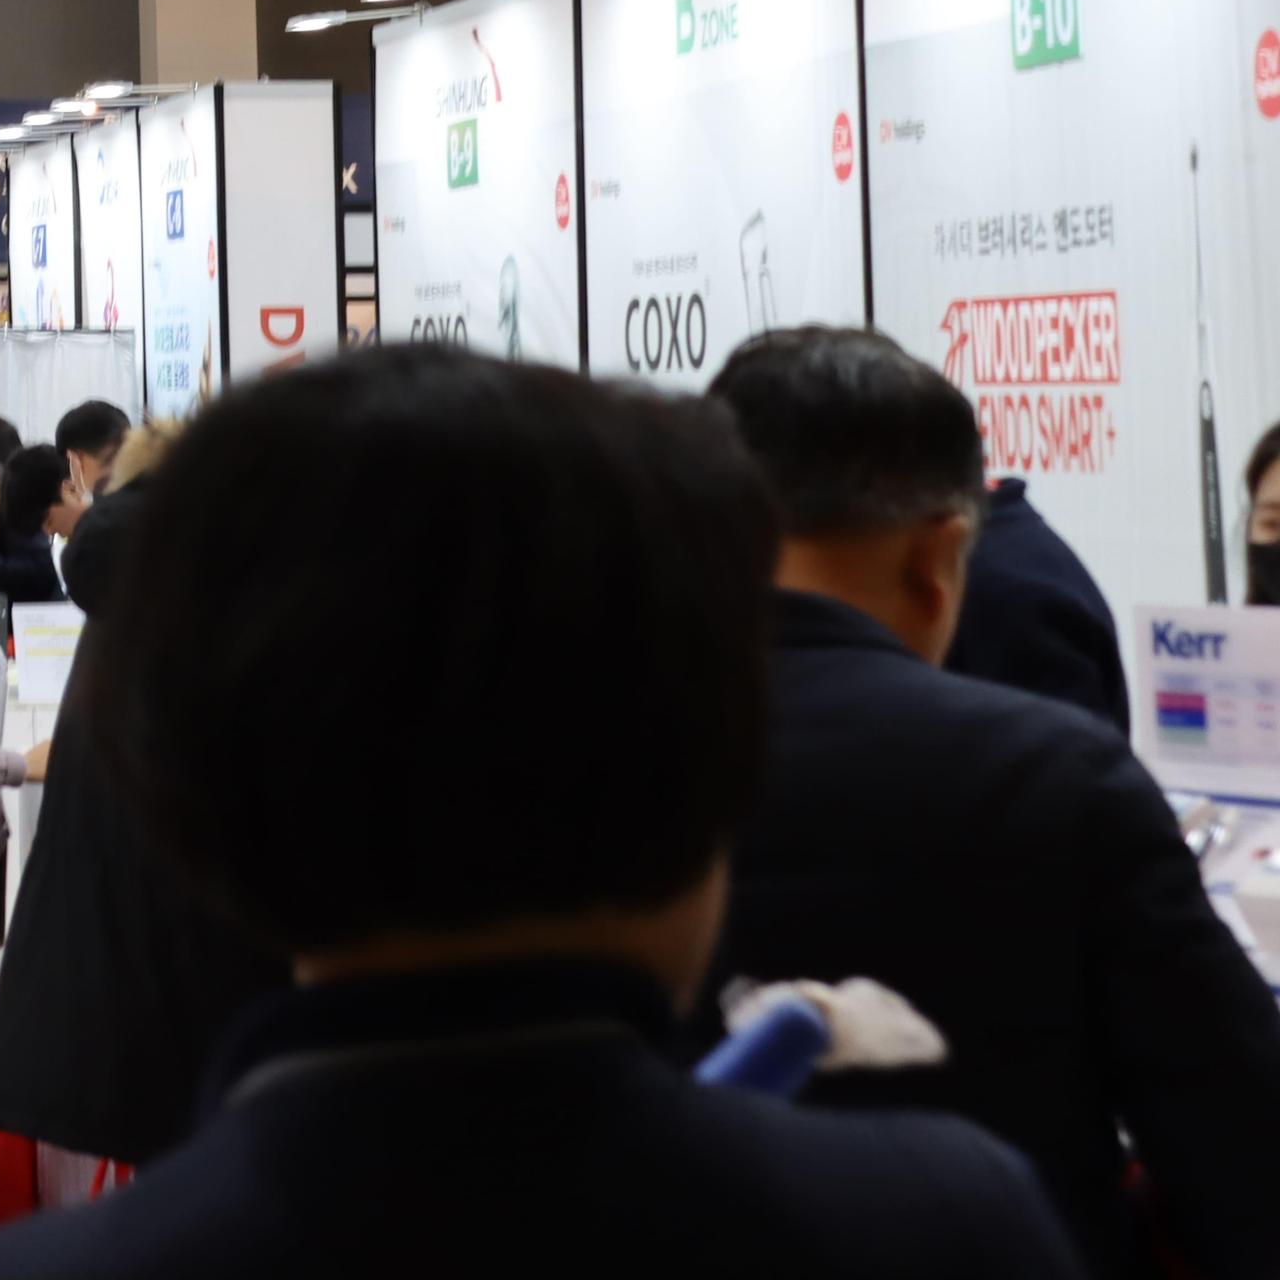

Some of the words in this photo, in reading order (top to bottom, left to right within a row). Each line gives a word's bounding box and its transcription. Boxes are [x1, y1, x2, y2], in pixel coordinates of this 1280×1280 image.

[701, 0, 739, 50] ZONE
[450, 127, 473, 181] B-9
[625, 293, 707, 372] COXO
[973, 297, 1118, 381] WOODPECKER
[1151, 621, 1228, 661] Kerr
